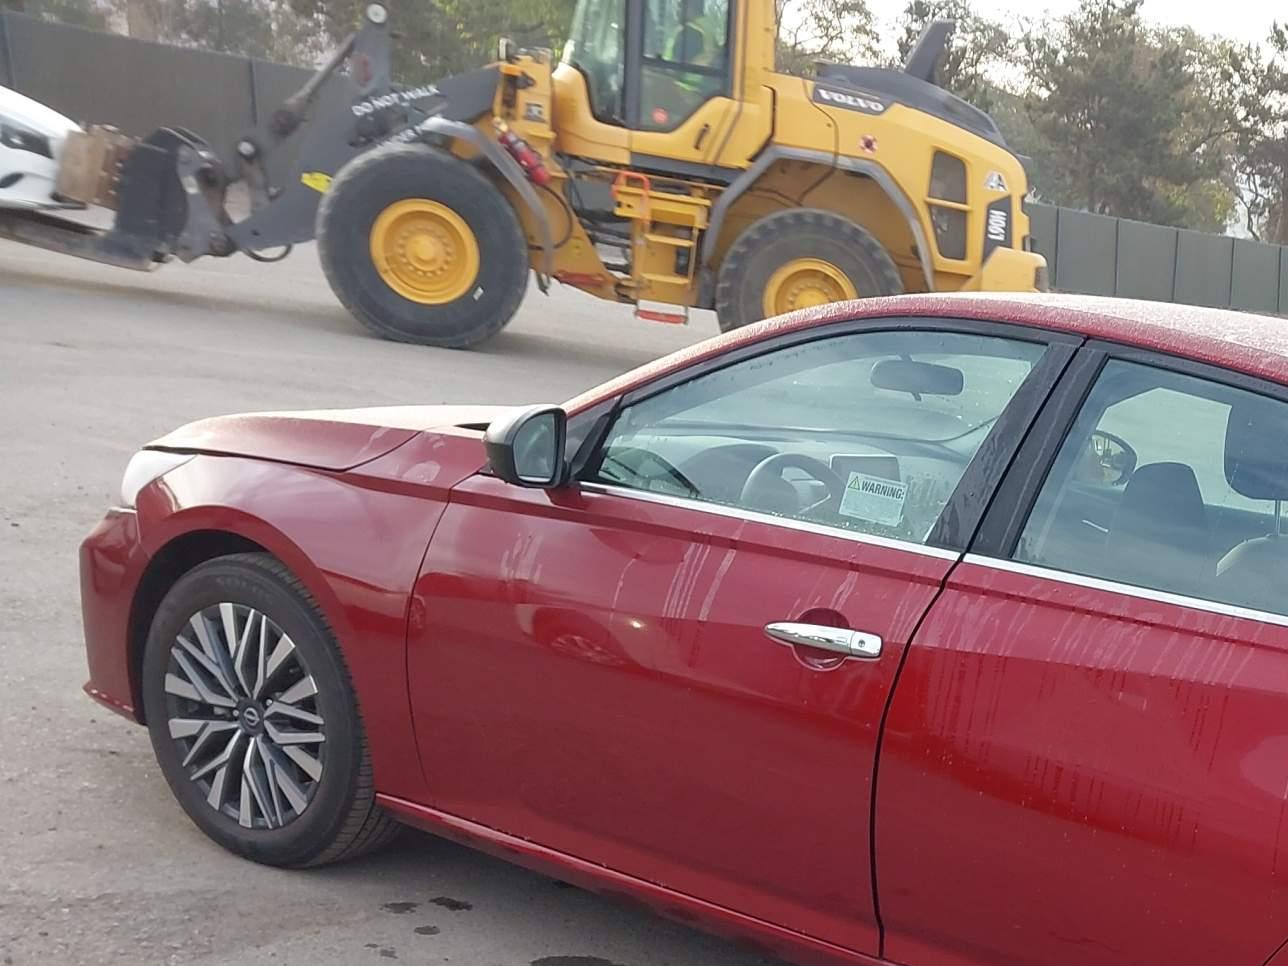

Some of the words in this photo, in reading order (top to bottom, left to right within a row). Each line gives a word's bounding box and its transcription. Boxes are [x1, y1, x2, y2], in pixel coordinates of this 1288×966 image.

[352, 102, 374, 116] DO
[370, 93, 400, 109] NOT
[817, 88, 885, 112] VOLVO
[987, 209, 1008, 241] L90H
[861, 480, 905, 500] WARNING:
